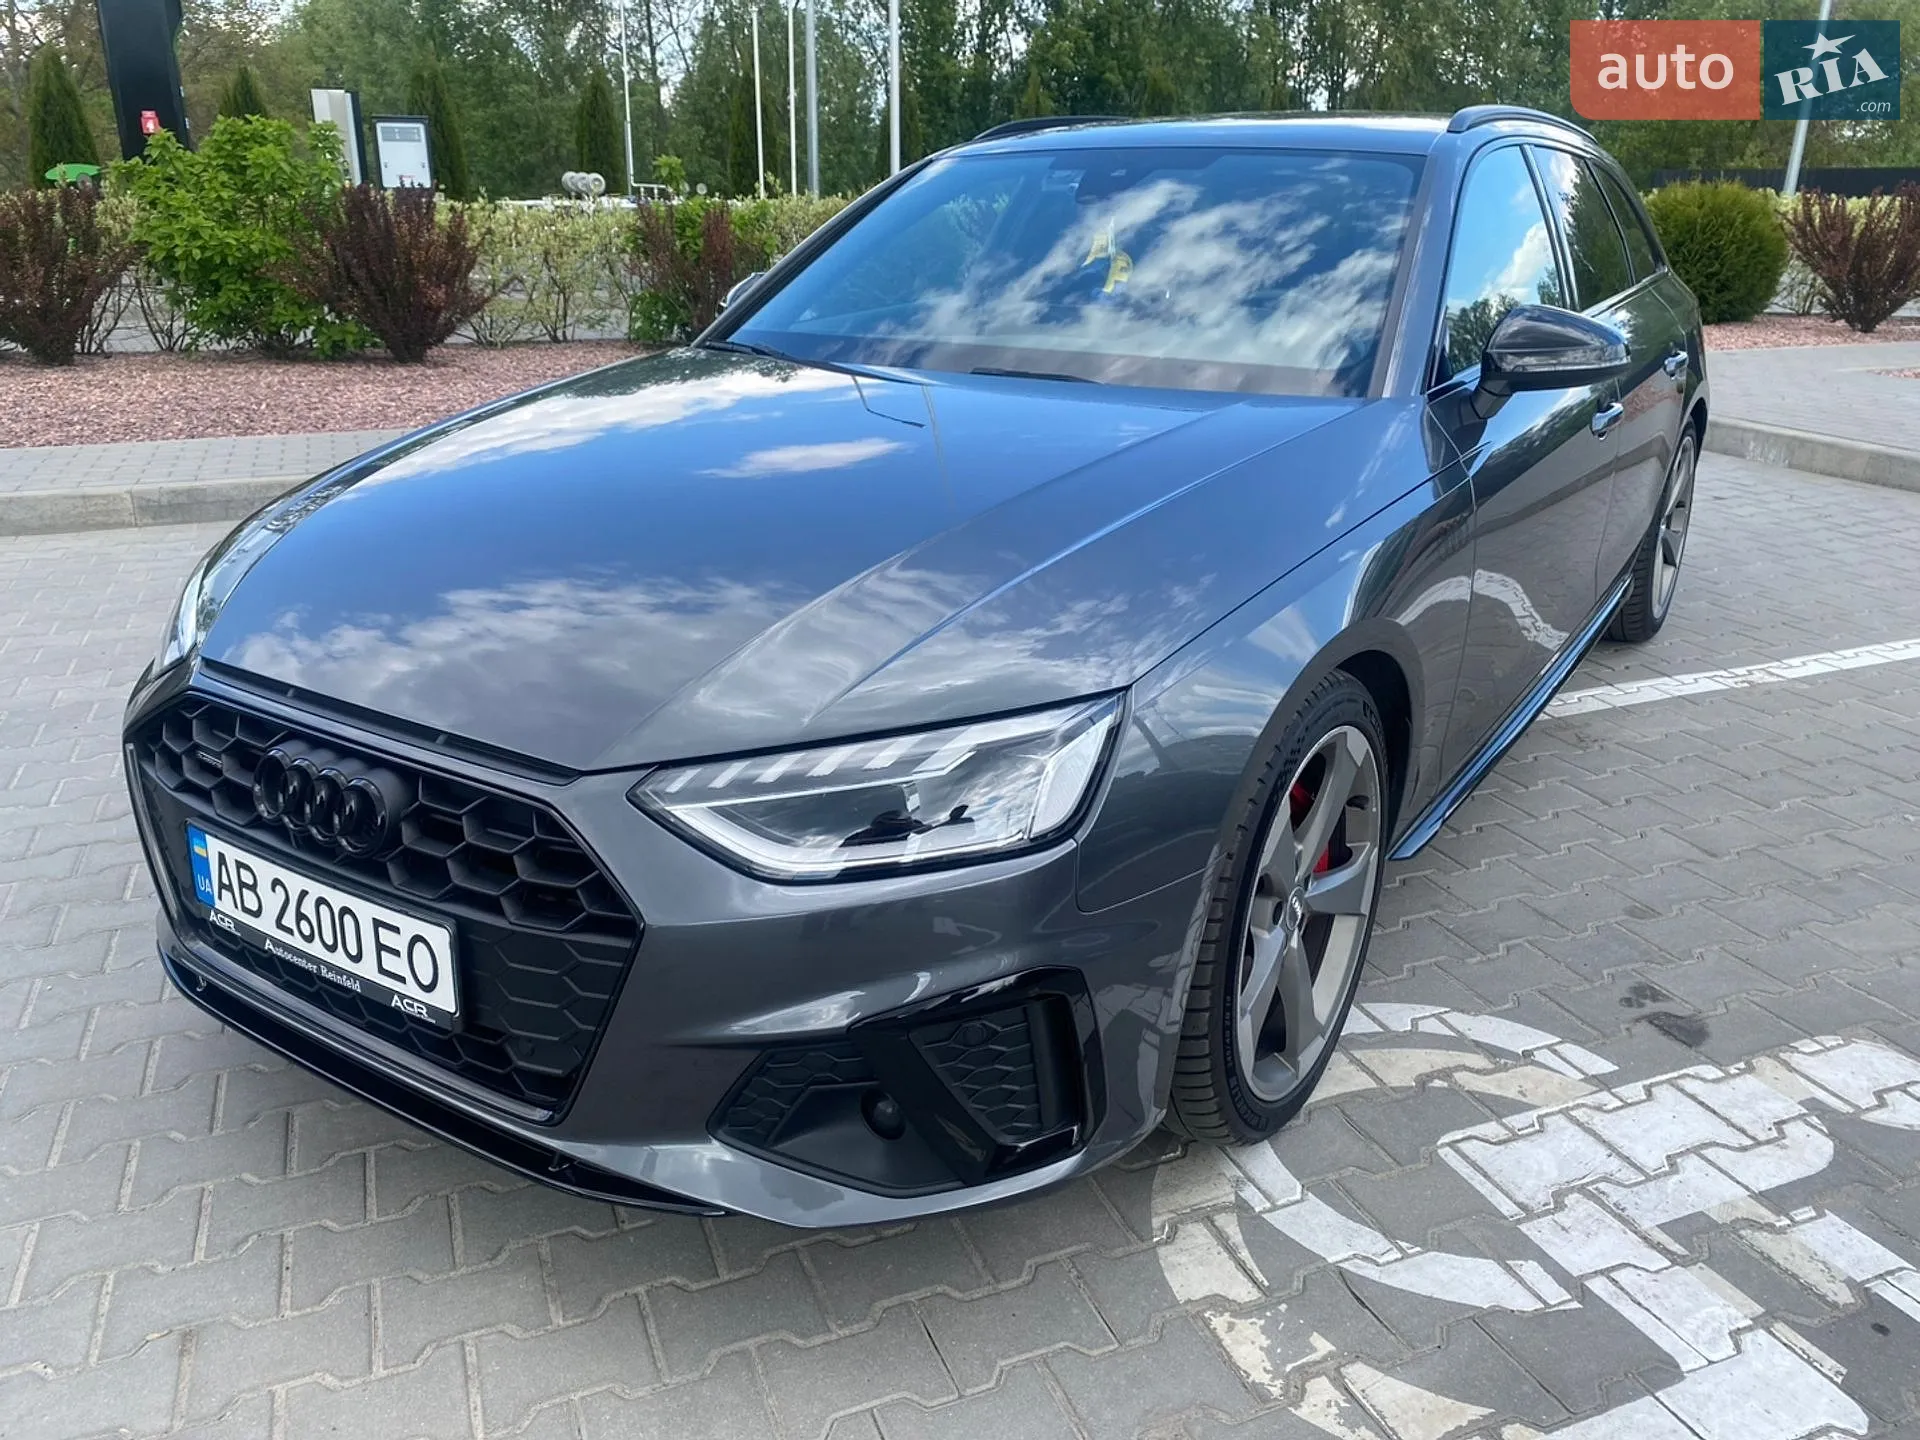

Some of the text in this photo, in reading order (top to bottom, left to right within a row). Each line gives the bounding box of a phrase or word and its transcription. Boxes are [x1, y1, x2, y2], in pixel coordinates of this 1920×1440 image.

[197, 875, 212, 895] UA
[210, 909, 236, 931] ACR
[217, 851, 439, 993] AB 2600 EO
[320, 966, 361, 993] Reinfeld
[391, 994, 428, 1018] ACR
